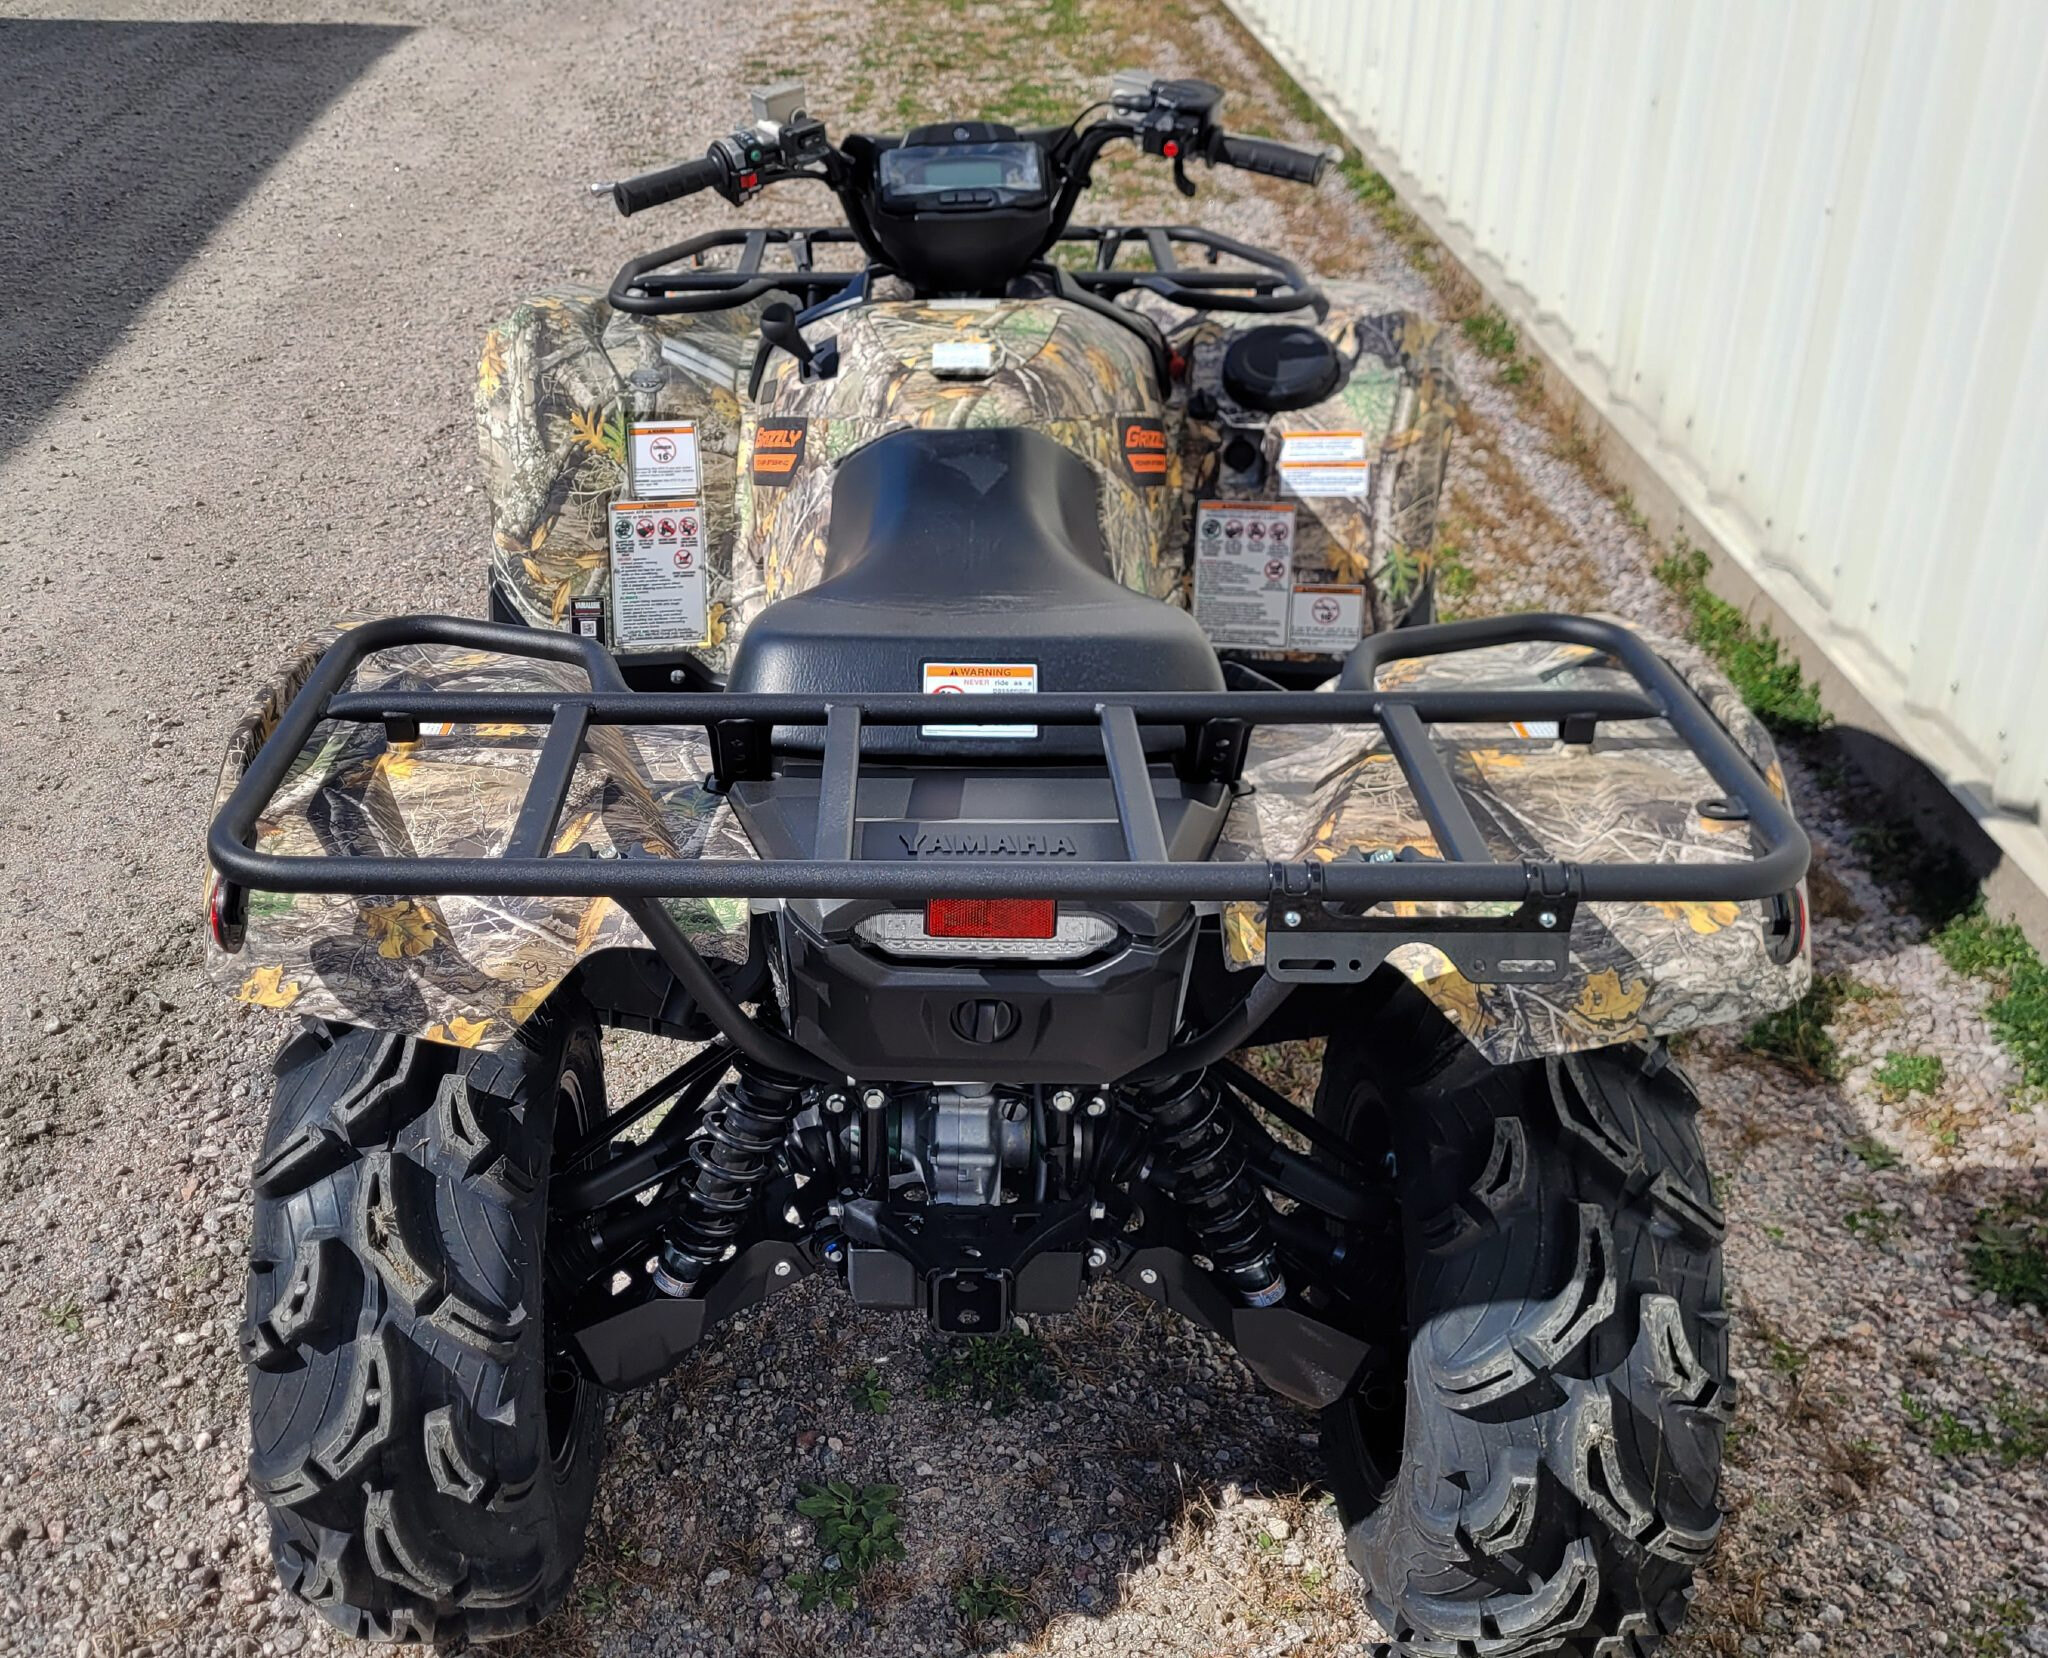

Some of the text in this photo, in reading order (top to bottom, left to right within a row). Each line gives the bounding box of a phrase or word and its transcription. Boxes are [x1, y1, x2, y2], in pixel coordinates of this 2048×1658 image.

[754, 427, 803, 448] GRIZZLY
[657, 453, 669, 461] 16
[960, 668, 1012, 677] WARNING
[899, 834, 1078, 856] YAMAHA
